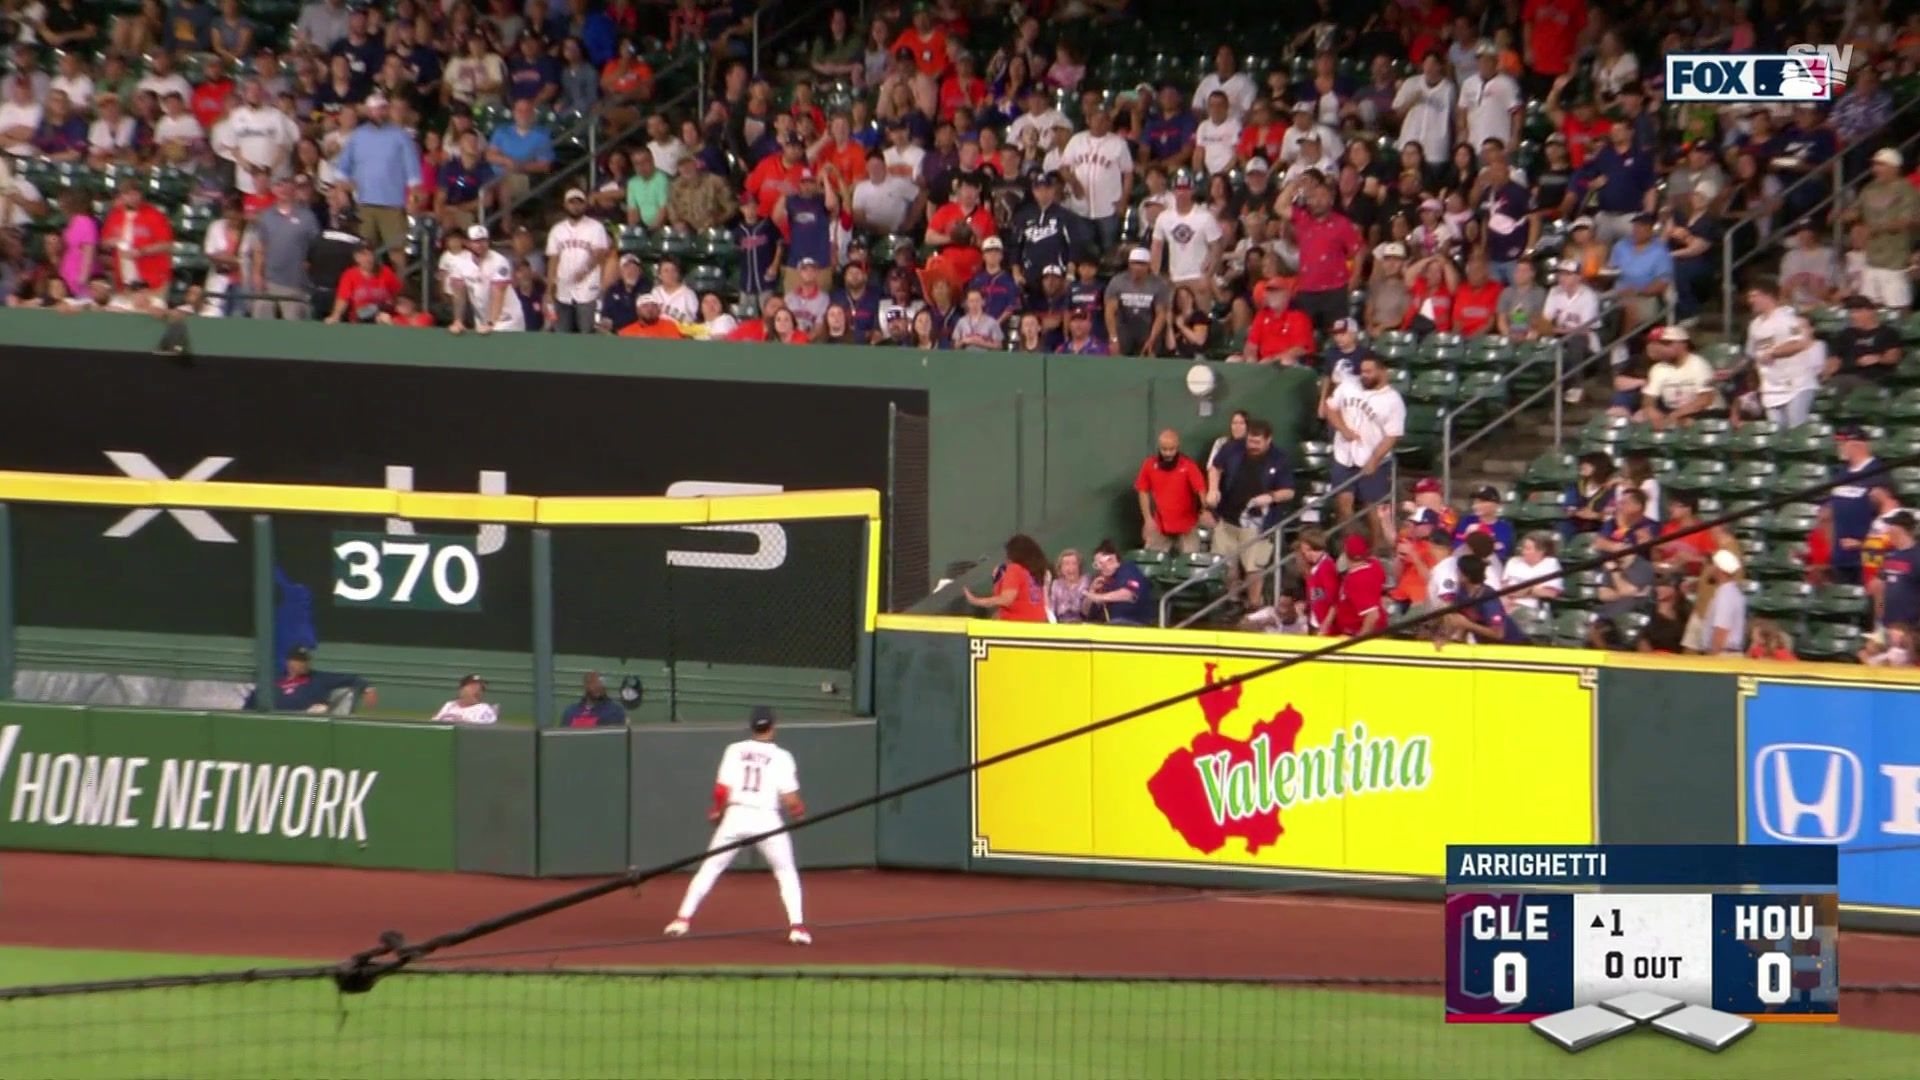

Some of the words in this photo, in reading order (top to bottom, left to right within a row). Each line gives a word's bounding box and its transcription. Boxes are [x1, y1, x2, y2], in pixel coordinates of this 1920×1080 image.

[333, 538, 480, 606] 370
[10, 752, 149, 828] HOME
[151, 758, 379, 841] NETWORK
[742, 765, 760, 792] 11
[1196, 722, 1430, 826] Valentina
